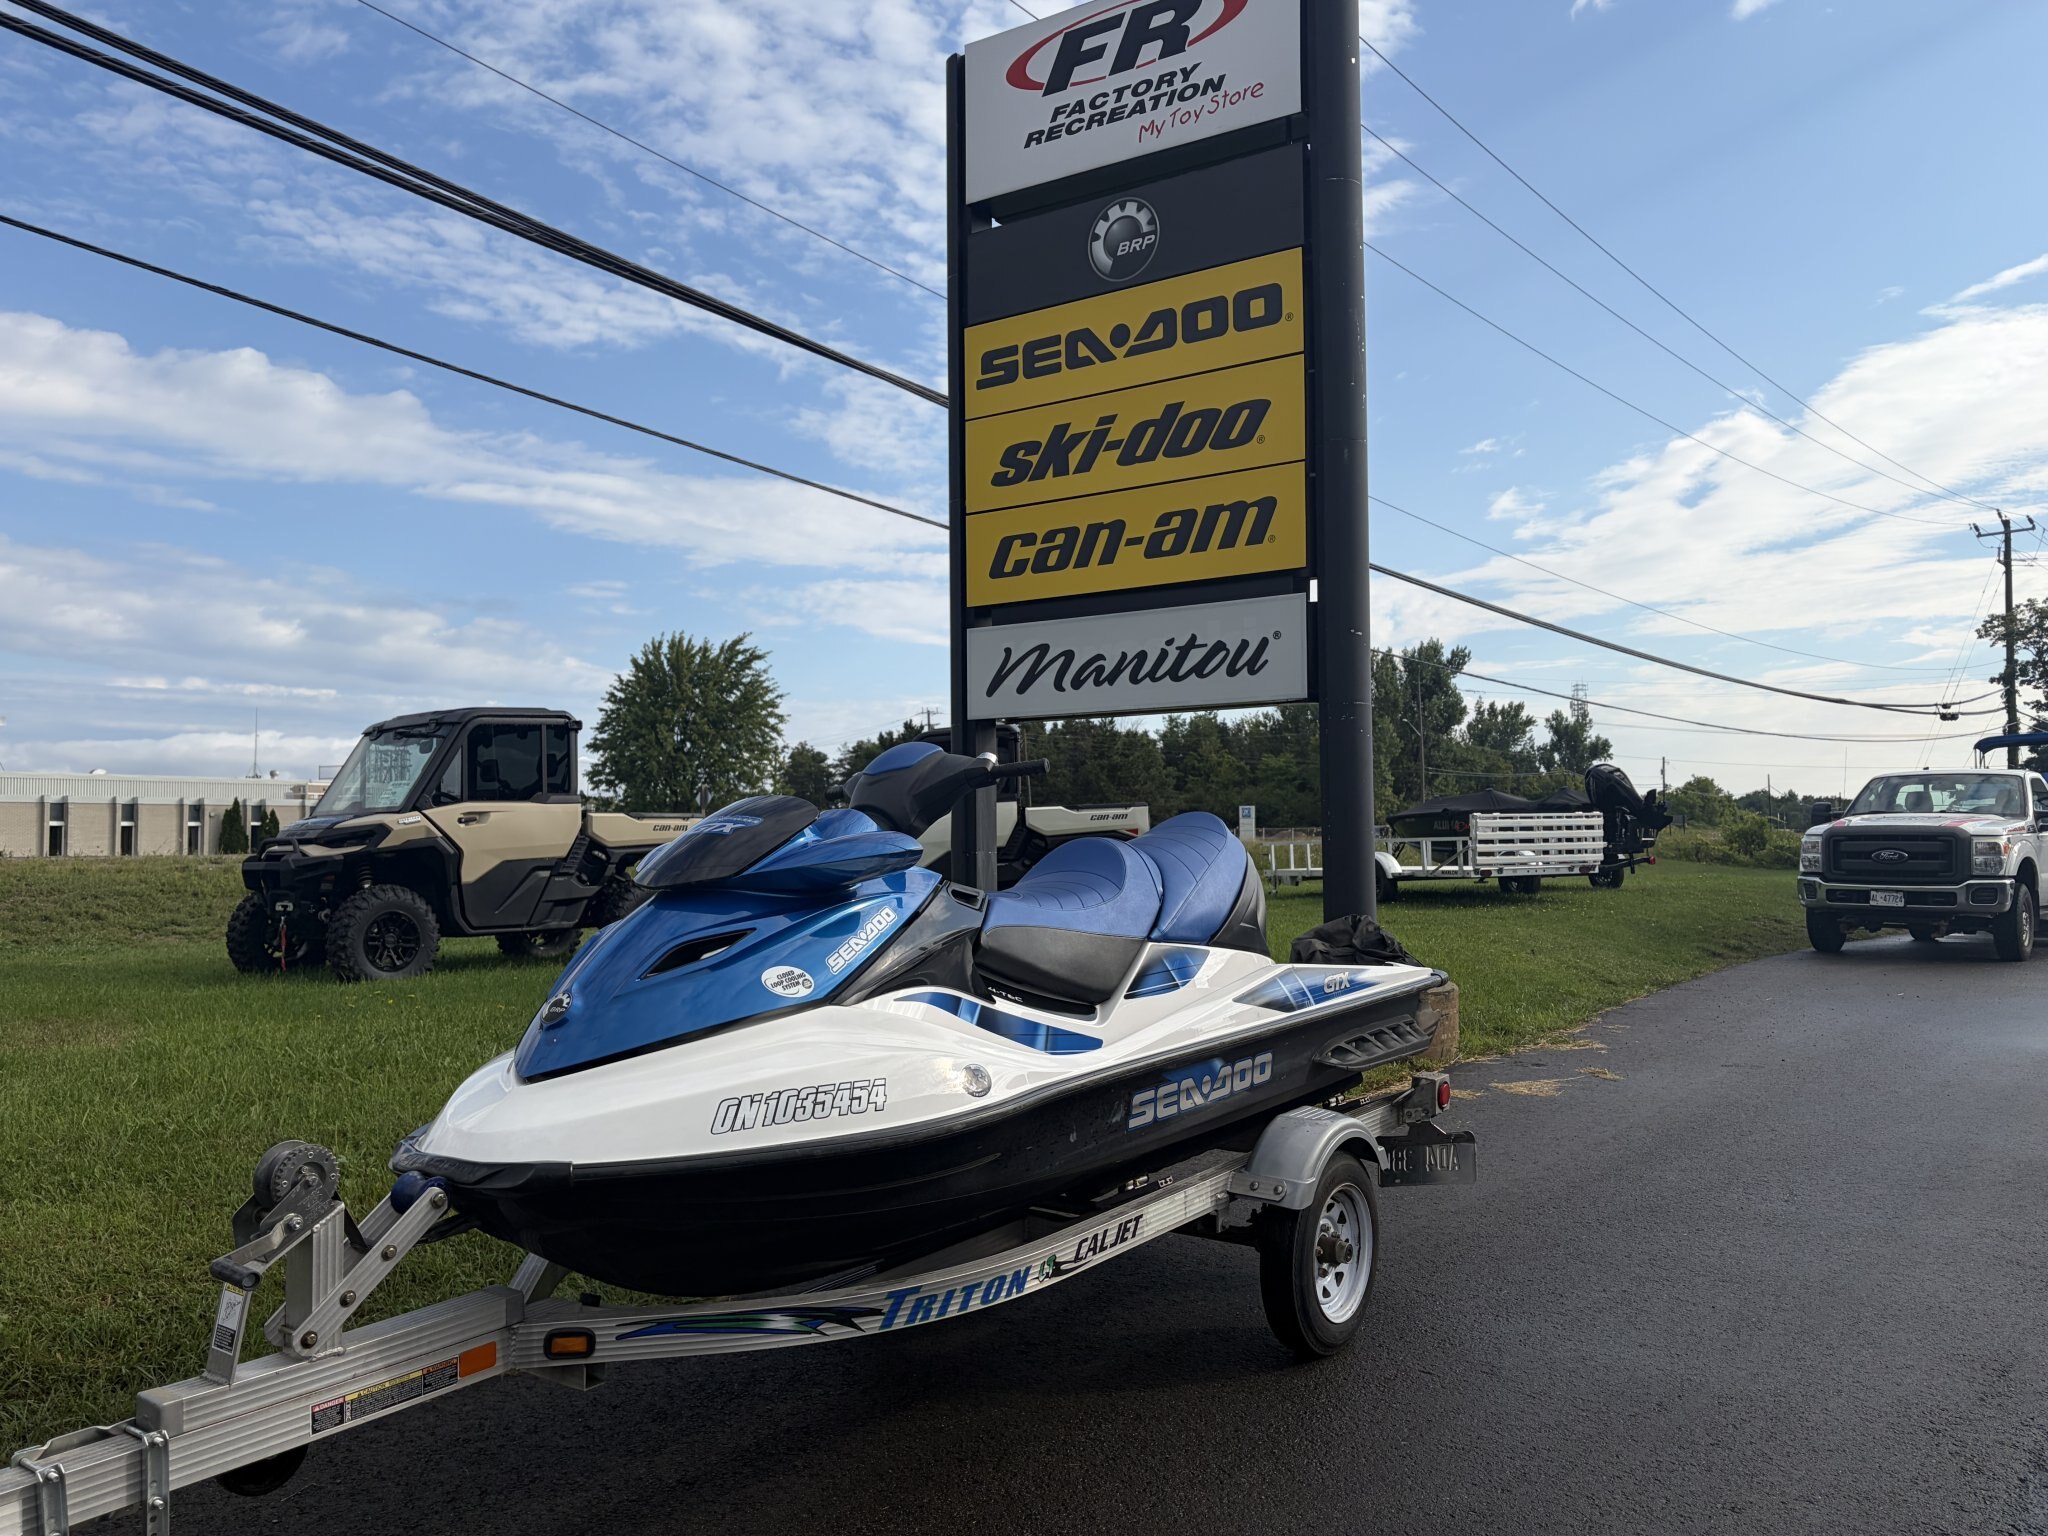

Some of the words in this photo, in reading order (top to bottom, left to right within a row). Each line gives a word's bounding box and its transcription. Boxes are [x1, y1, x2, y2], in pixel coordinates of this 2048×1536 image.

[1042, 0, 1201, 97] FR
[1024, 74, 1226, 149] RECREATION
[1049, 62, 1202, 123] FACTORY
[1138, 119, 1166, 143] My
[1169, 105, 1204, 124] Toy
[1206, 81, 1264, 115] Store
[1116, 234, 1156, 256] BRP
[990, 398, 1272, 487] ski-doo
[988, 496, 1278, 580] can-am
[985, 633, 1270, 698] Manitou
[1089, 812, 1128, 821] can-am
[770, 980, 784, 989] LOOP
[785, 972, 806, 984] COOLING
[776, 970, 795, 980] CLOSED
[781, 980, 801, 991] SYSTEM
[1323, 972, 1350, 993] GTX
[710, 1093, 764, 1135] ON
[762, 1077, 887, 1127] 1035454
[878, 1265, 1032, 1330] TRITON
[1073, 1214, 1144, 1263] CALJET
[319, 1397, 344, 1410] DANGER
